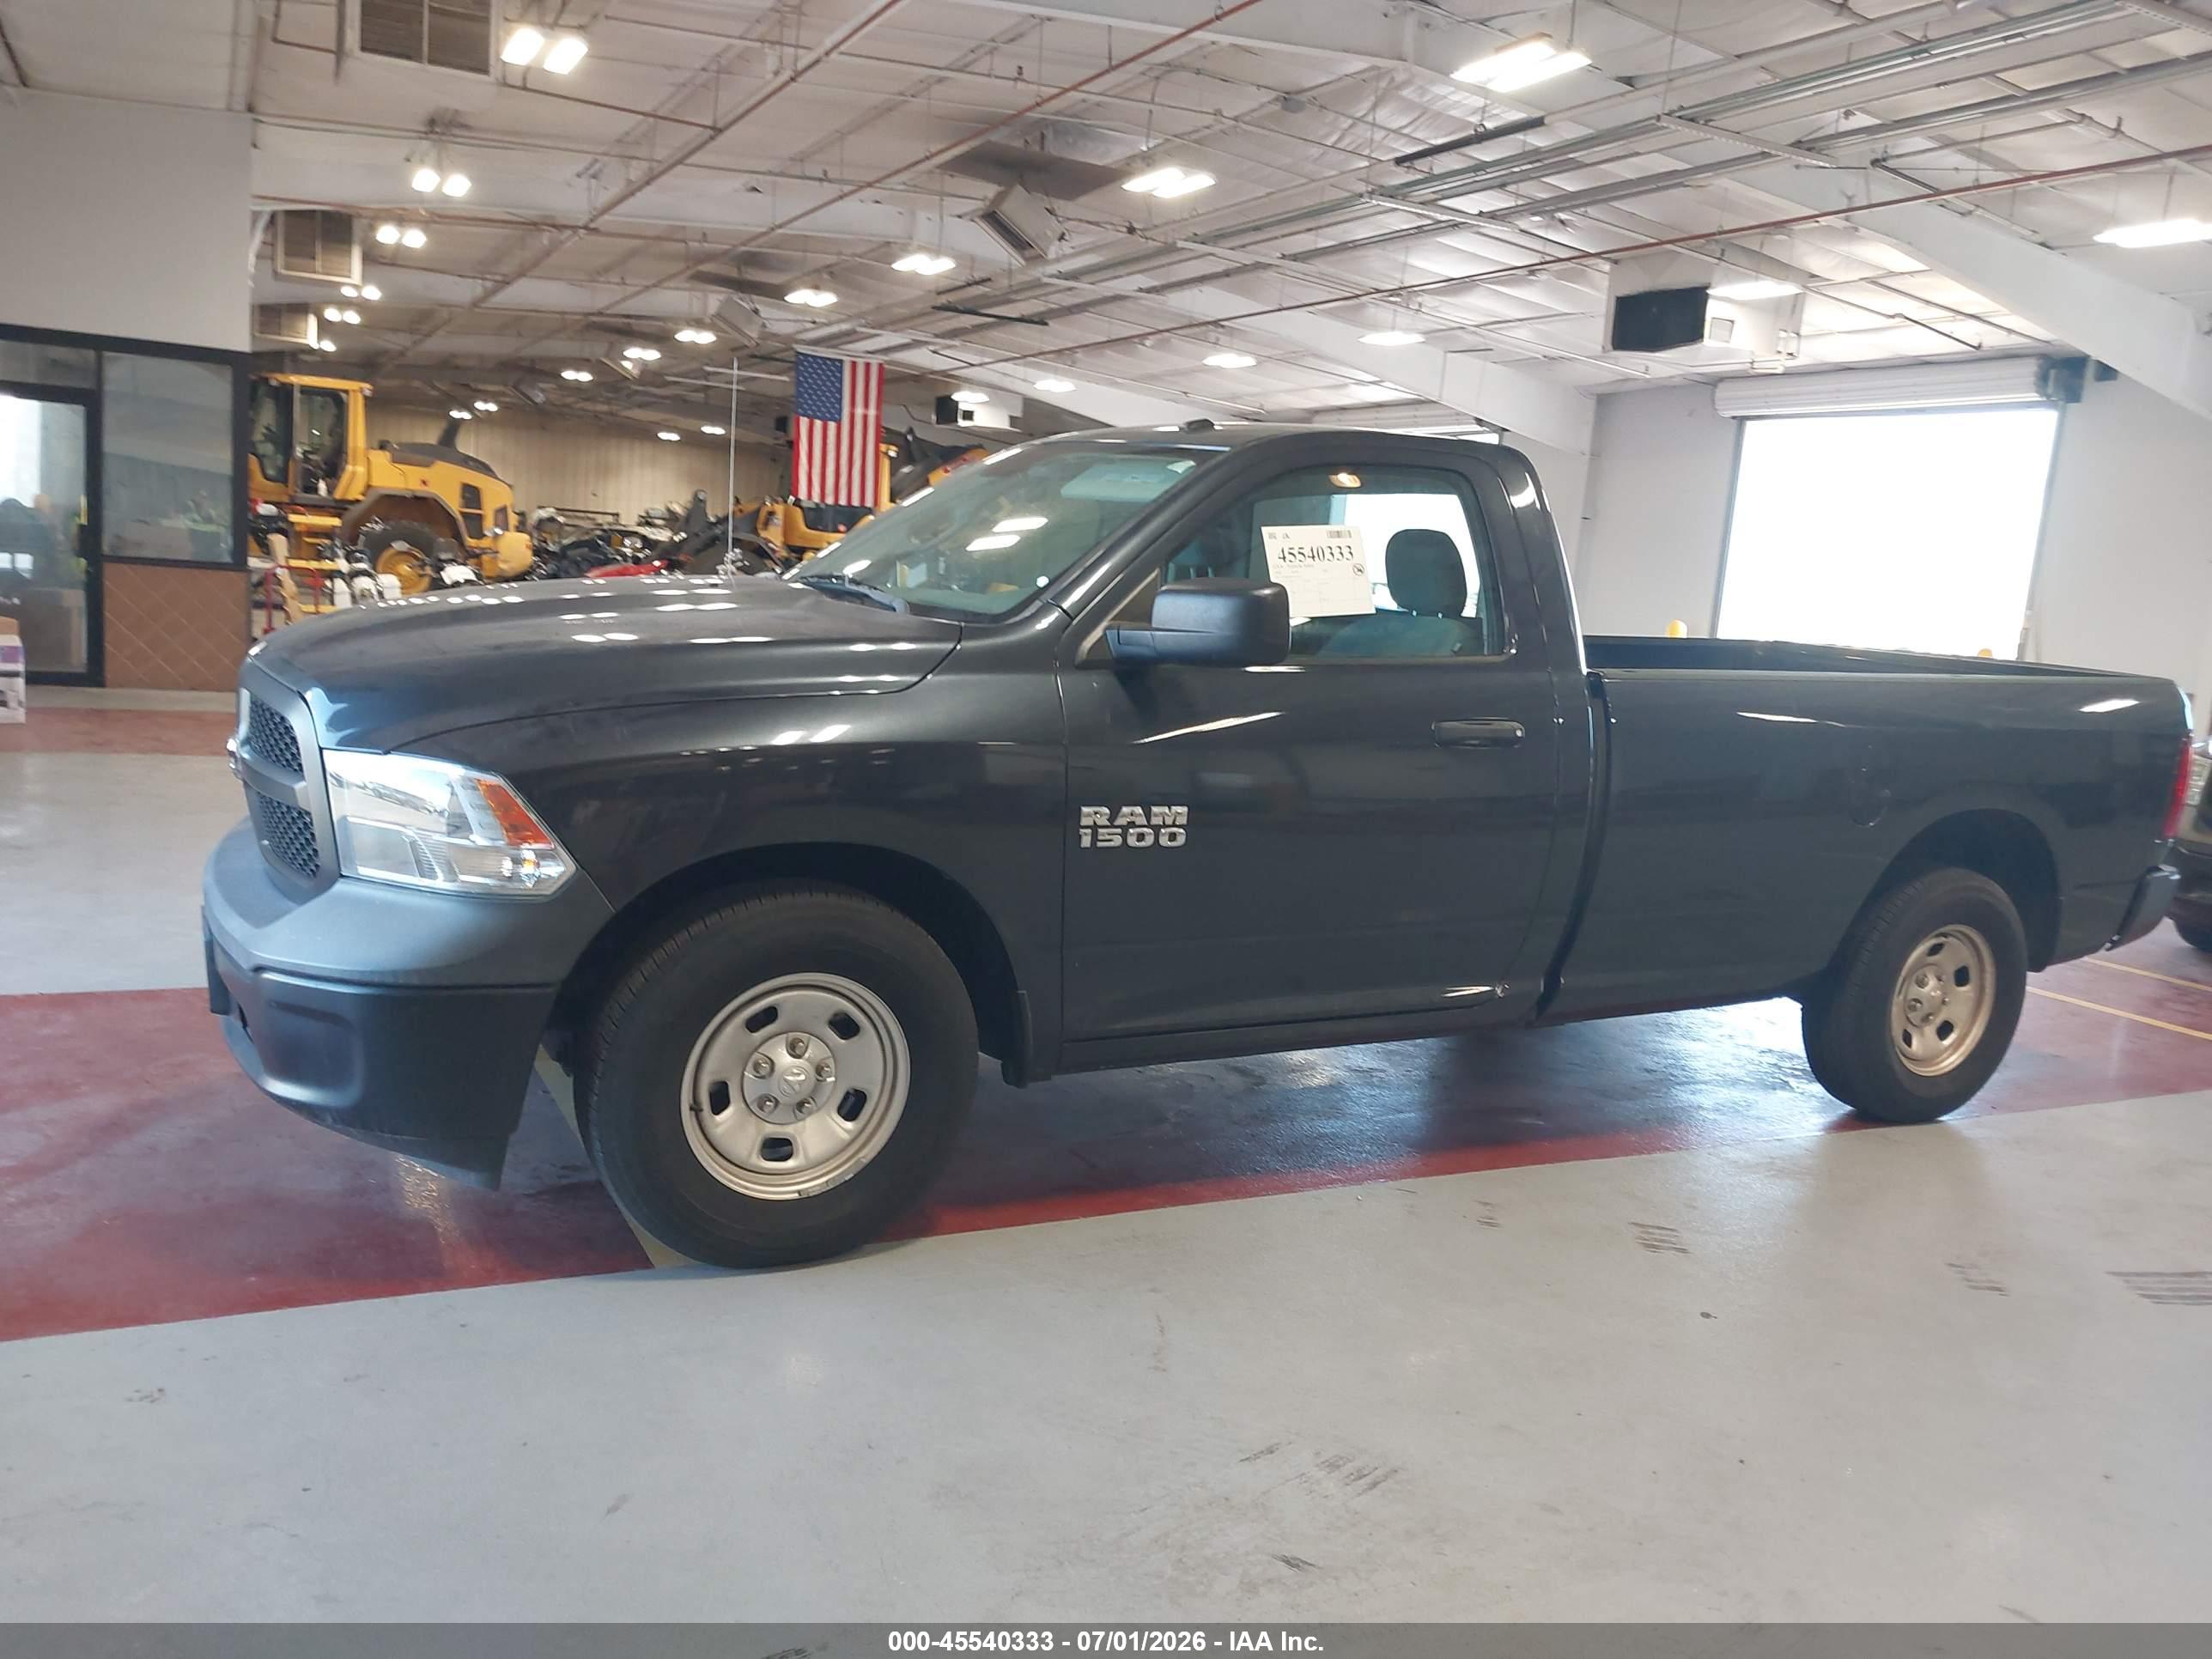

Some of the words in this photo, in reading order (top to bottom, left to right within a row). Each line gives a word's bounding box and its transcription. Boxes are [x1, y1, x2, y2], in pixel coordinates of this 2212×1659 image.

[1278, 545, 1354, 563] 45540333
[1079, 805, 1188, 825] RAM
[1079, 827, 1187, 848] 1500
